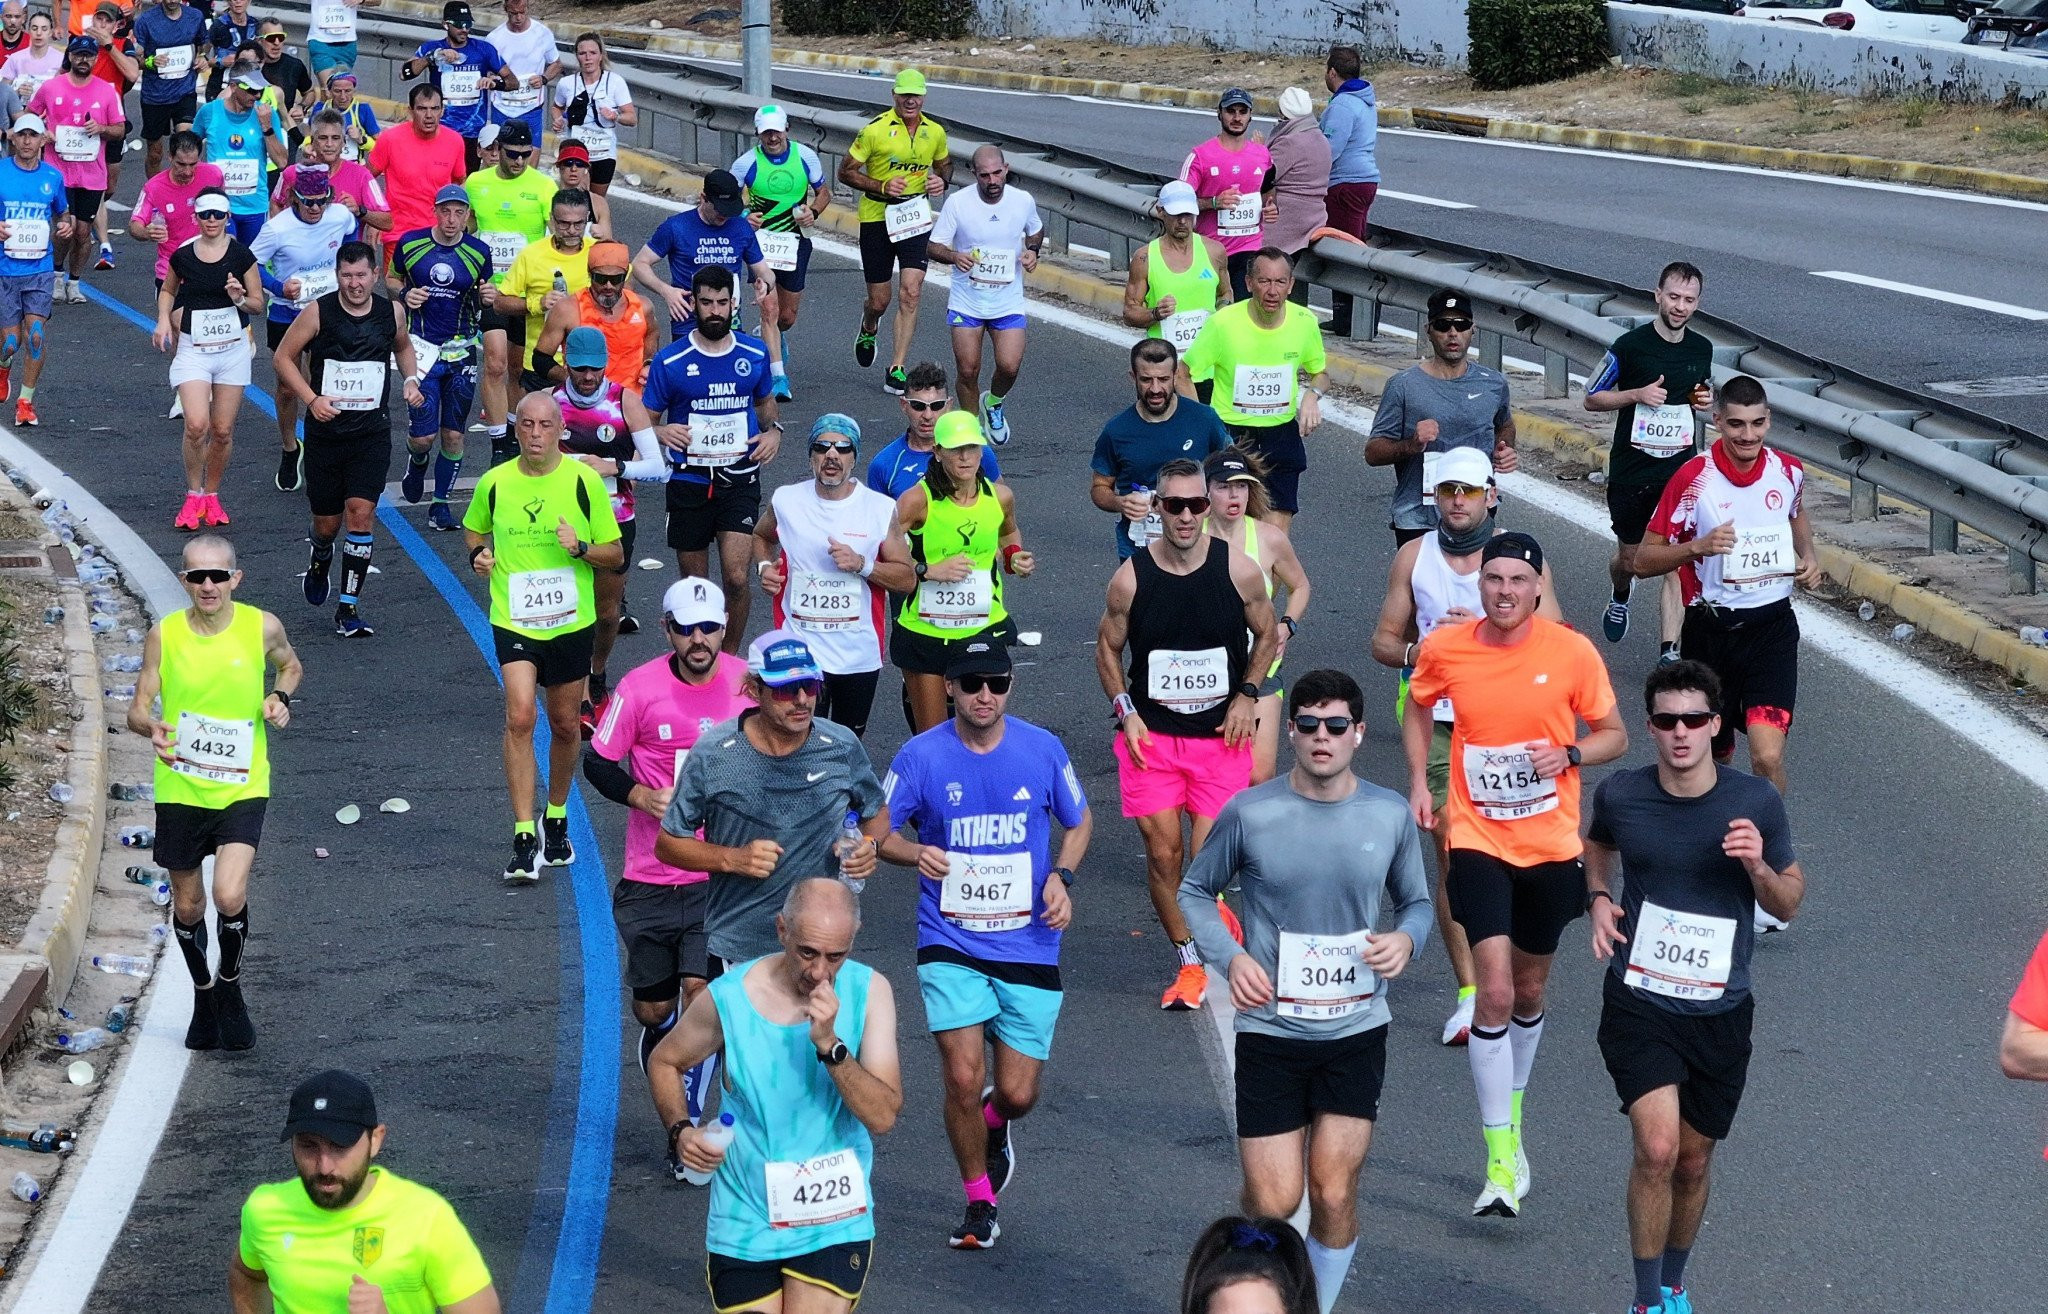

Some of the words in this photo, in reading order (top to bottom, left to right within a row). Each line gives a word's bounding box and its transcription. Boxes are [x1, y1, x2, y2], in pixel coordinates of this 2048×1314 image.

[168, 57, 185, 66] 810
[450, 84, 472, 92] 5825
[66, 139, 83, 148] 256
[224, 172, 249, 181] 6447
[5, 206, 46, 220] ITALIA
[896, 211, 920, 224] 6039
[1229, 209, 1254, 220] 5398
[18, 233, 38, 243] 860
[699, 237, 717, 245] run
[718, 236, 730, 245] to
[489, 246, 515, 257] 2381
[696, 245, 734, 256] change
[762, 243, 789, 254] 3877
[693, 254, 737, 264] diabetes
[979, 263, 1005, 274] 5471
[203, 324, 231, 337] 3462
[334, 379, 363, 391] 1971
[1247, 383, 1280, 396] 3539
[1646, 423, 1682, 438] 6027
[701, 432, 735, 447] 4648
[1740, 549, 1779, 569] 7841
[524, 589, 564, 609] 2419
[800, 593, 851, 610] 21283
[935, 591, 976, 606] 3238
[1160, 673, 1217, 690] 21659
[190, 738, 236, 758] 4432
[1478, 769, 1542, 790] 12154
[950, 812, 1027, 848] ATHENS
[960, 882, 1012, 901] 9467
[1653, 940, 1711, 969] 3045
[1301, 965, 1357, 987] 3044
[793, 1175, 851, 1206] 4228
